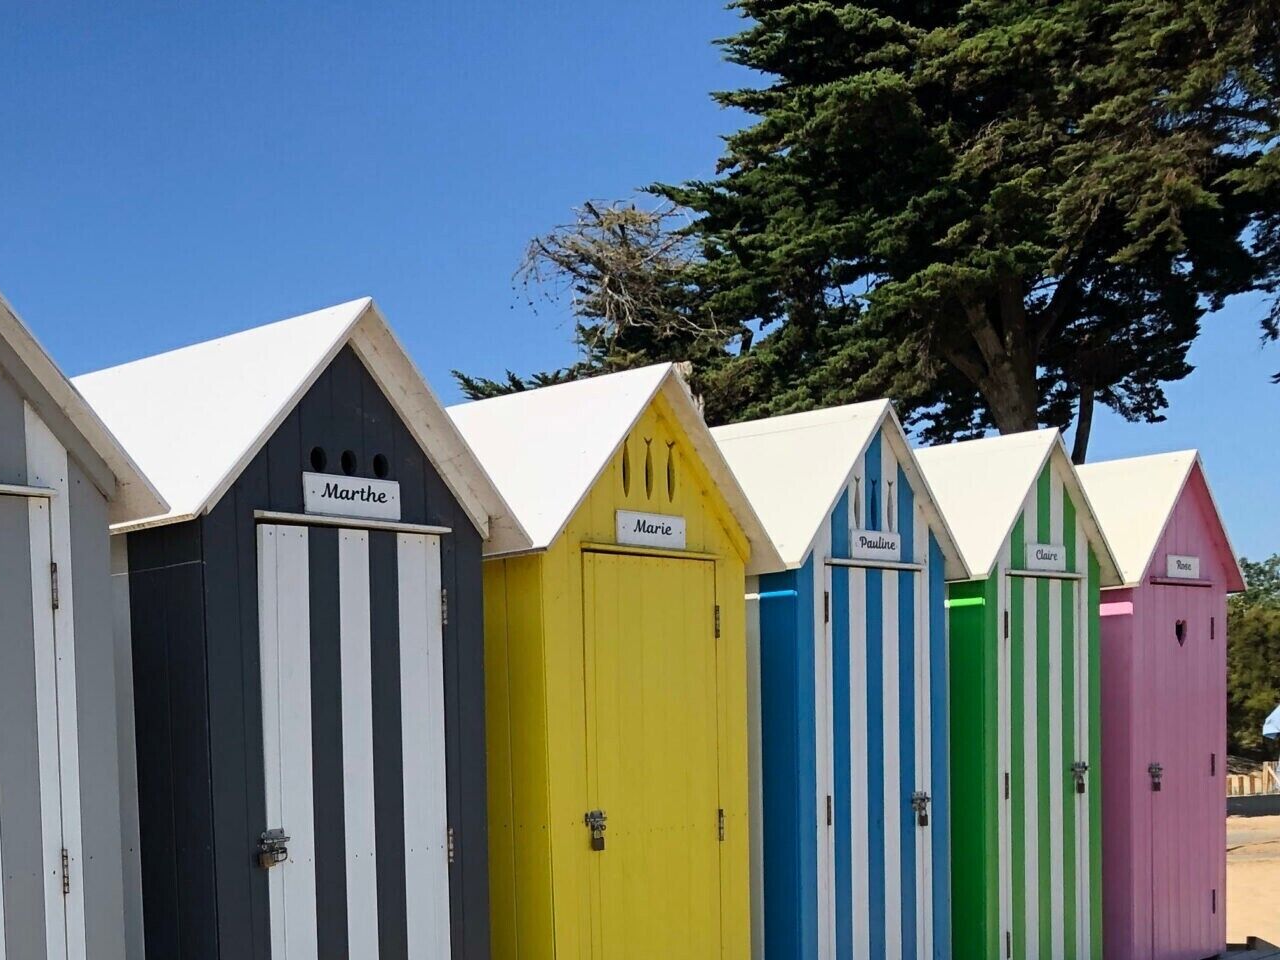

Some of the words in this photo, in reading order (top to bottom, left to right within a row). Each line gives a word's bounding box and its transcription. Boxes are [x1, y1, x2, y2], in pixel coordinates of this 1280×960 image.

[321, 483, 388, 503] Marthe
[633, 519, 672, 535] Marie
[859, 536, 896, 550] Pauline
[1036, 549, 1058, 560] Claire
